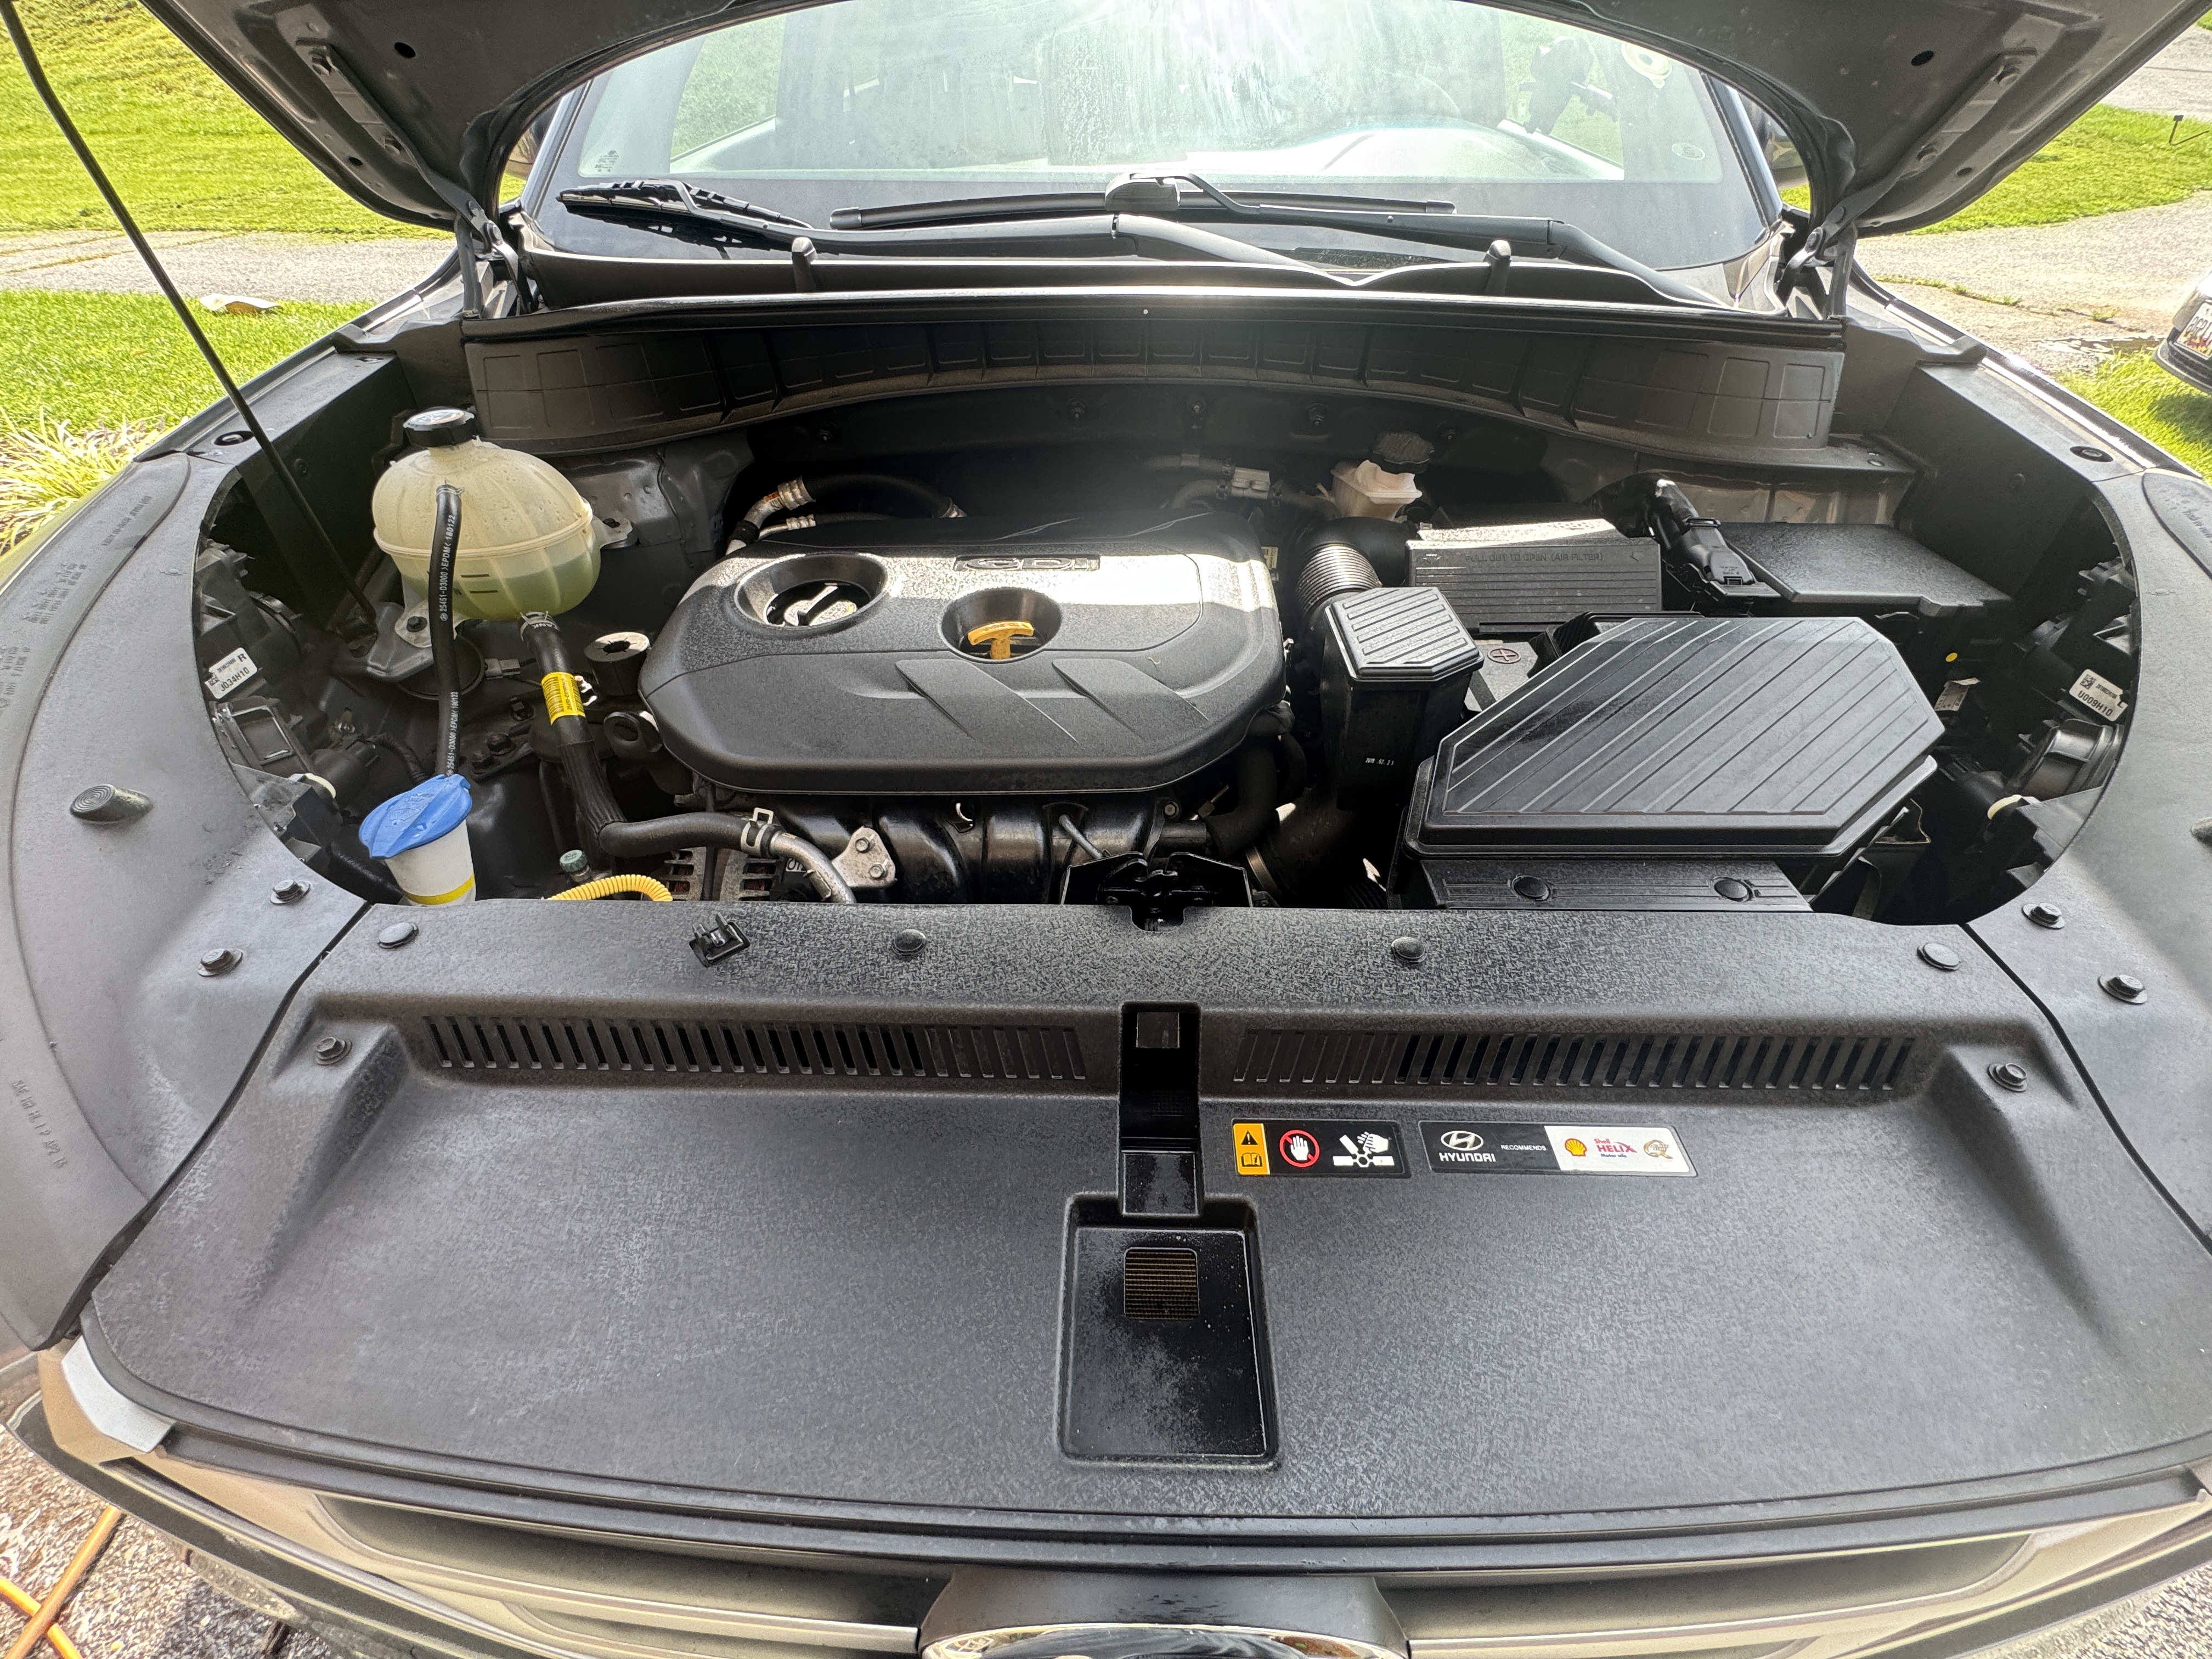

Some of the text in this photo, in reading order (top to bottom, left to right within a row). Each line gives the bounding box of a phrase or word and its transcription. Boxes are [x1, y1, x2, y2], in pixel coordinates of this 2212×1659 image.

[1465, 554, 1487, 562] PULL
[1489, 554, 1506, 562] OUT
[439, 572, 449, 612] 25451-D3000
[238, 653, 247, 662] R
[220, 667, 250, 692] J034H10
[2078, 690, 2113, 716] U009H10
[446, 732, 457, 769] 25451-D3000
[1438, 1151, 1496, 1163] HYUNDAI
[1596, 1143, 1637, 1153] HELIX
